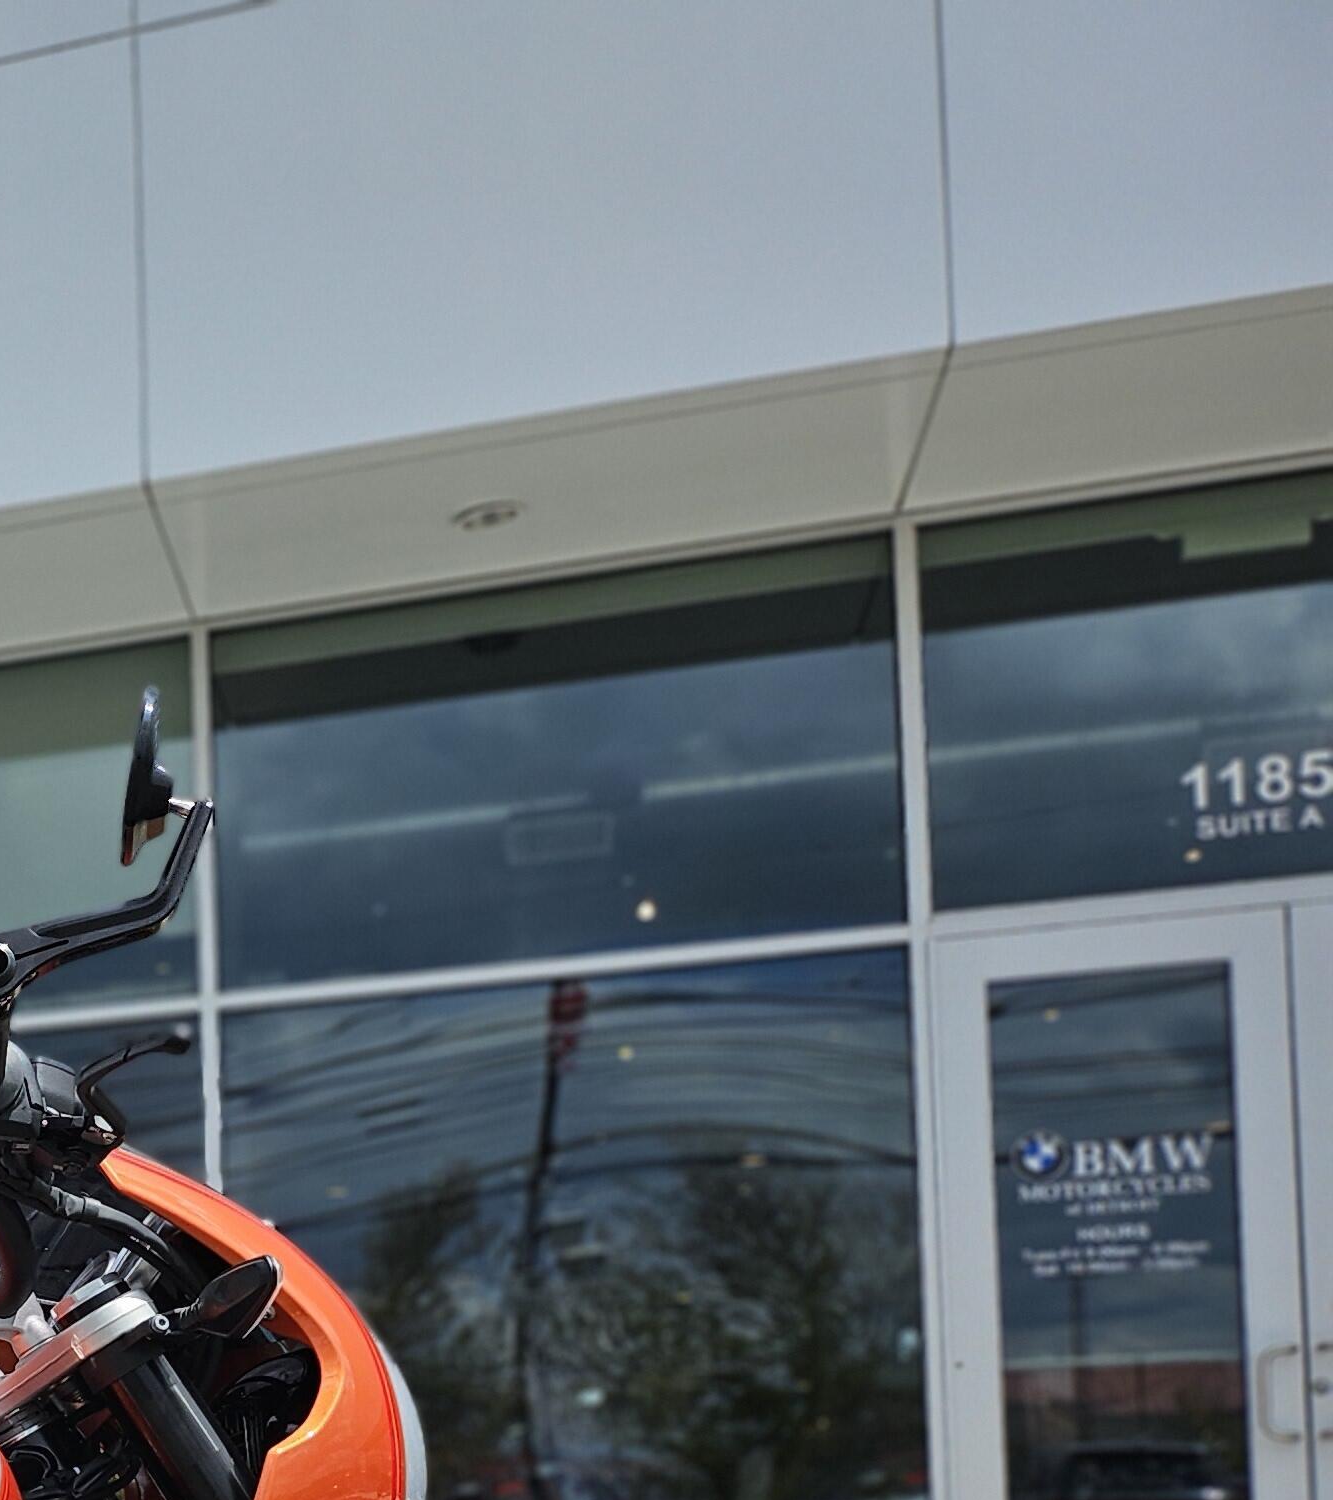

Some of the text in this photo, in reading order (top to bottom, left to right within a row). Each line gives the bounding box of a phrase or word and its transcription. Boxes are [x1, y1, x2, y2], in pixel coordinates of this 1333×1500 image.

[1195, 803, 1324, 841] SUITE A
[1072, 1134, 1213, 1177] BMW
